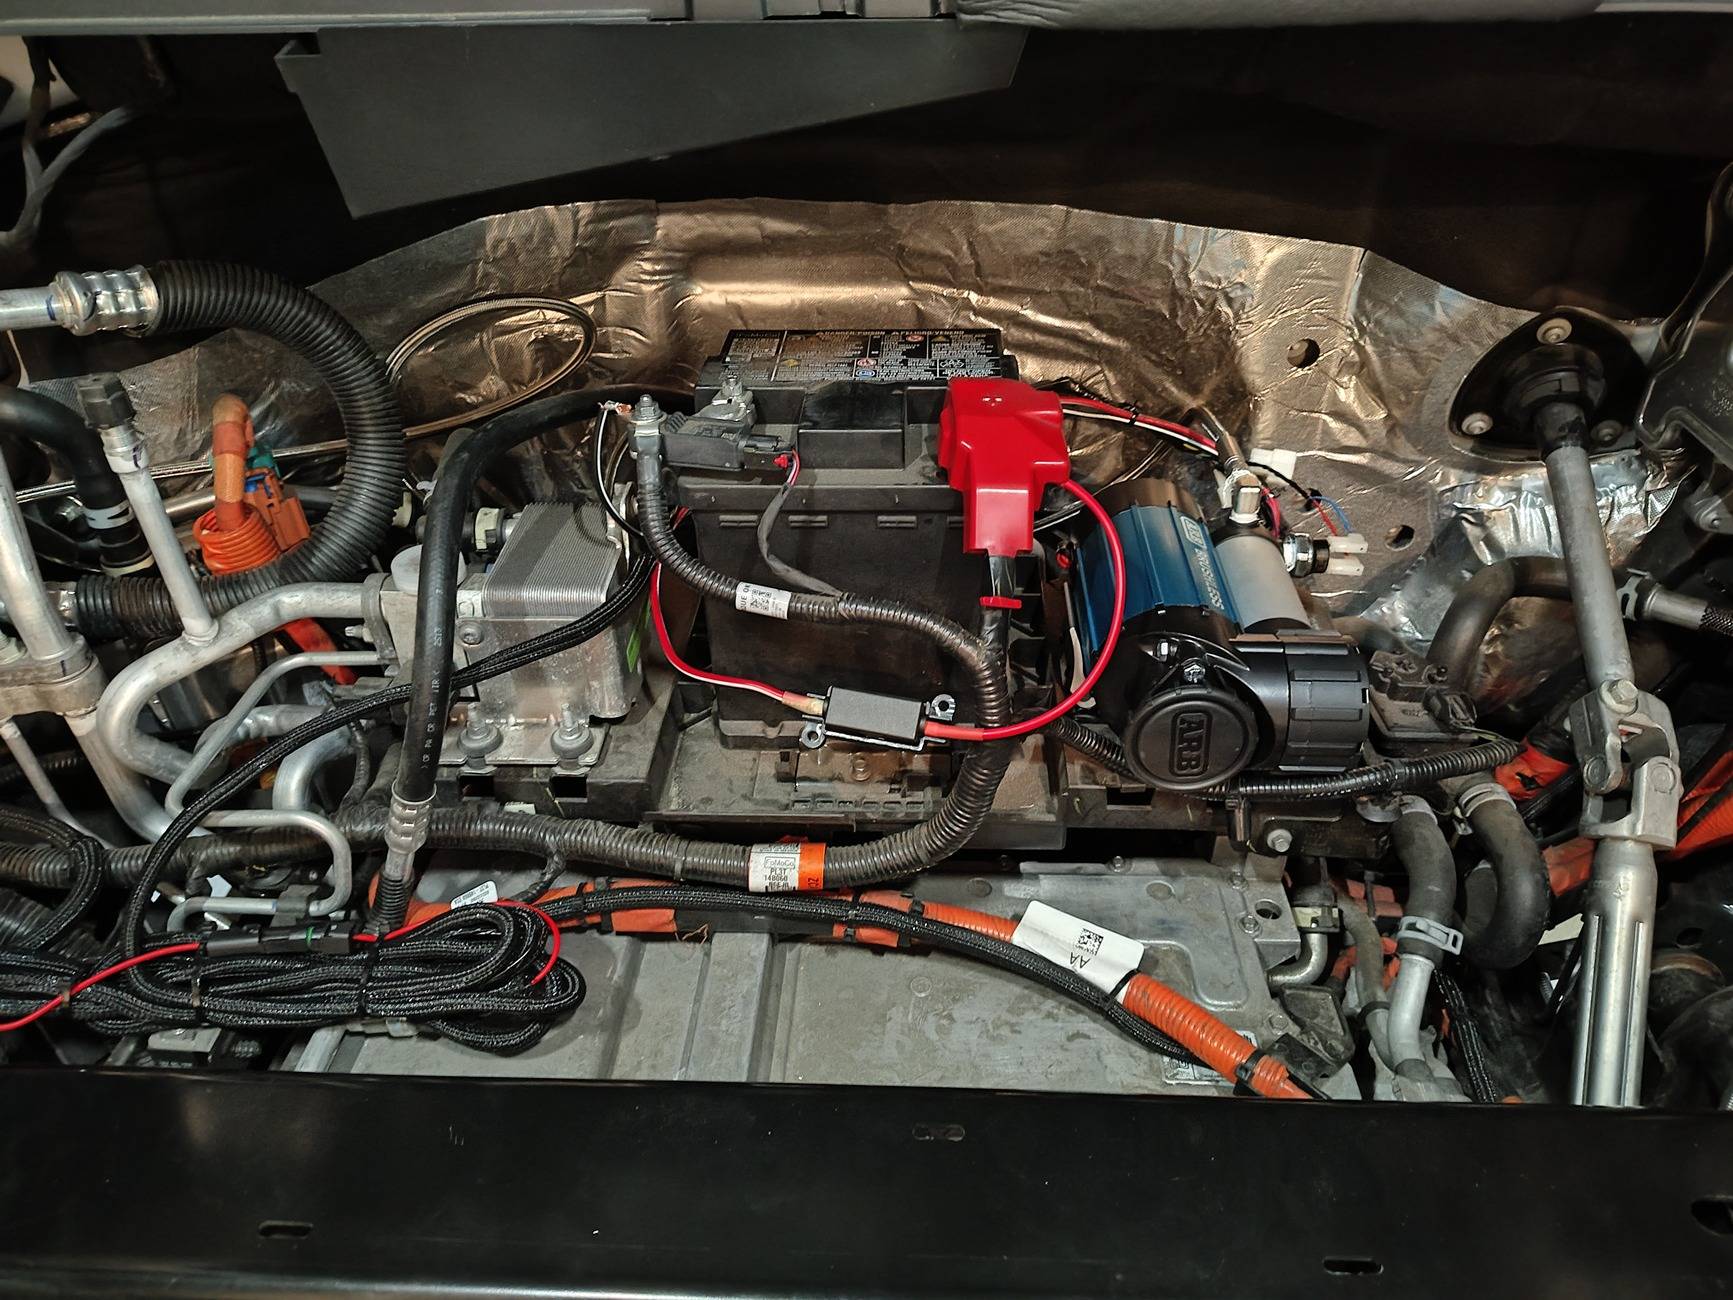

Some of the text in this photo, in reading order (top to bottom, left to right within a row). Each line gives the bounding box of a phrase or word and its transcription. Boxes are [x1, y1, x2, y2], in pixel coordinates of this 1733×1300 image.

[1179, 715, 1203, 771] ARB
[766, 858, 794, 867] FoMoCo
[1070, 951, 1091, 969] AA
